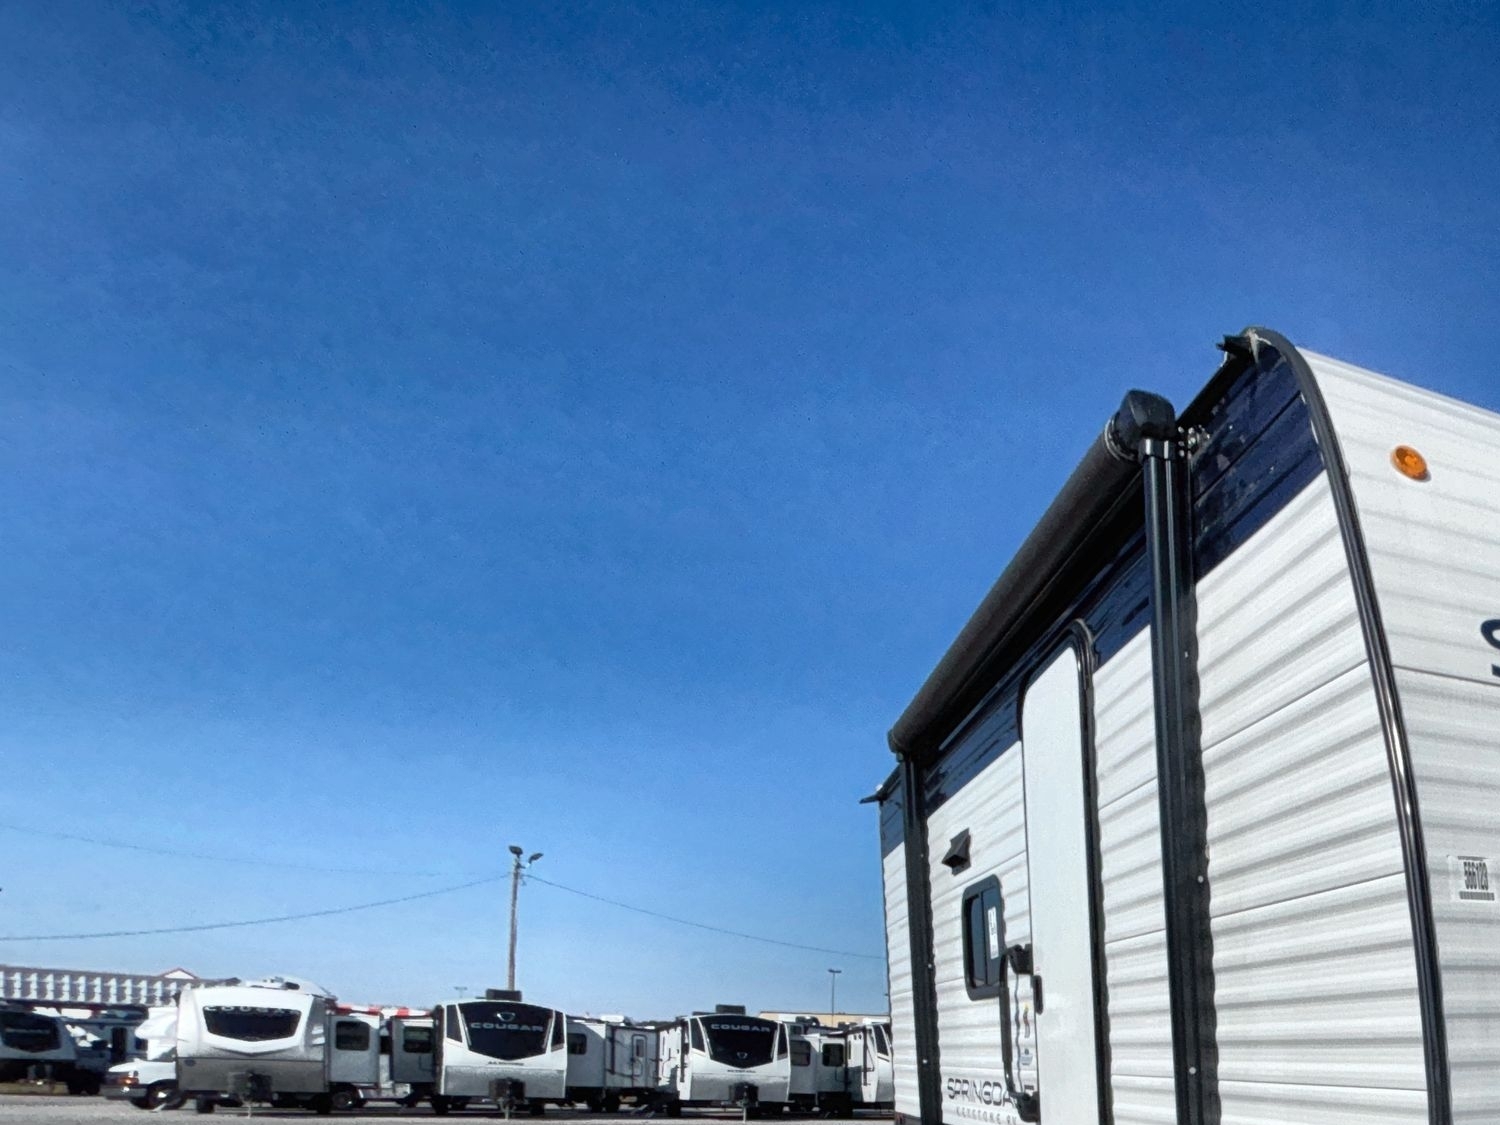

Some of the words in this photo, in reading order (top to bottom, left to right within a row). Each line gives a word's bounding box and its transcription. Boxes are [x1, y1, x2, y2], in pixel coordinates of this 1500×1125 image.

[470, 1022, 544, 1032] COUGAR
[711, 1023, 770, 1033] COUGAR
[947, 1077, 1035, 1109] SPRINGDA
